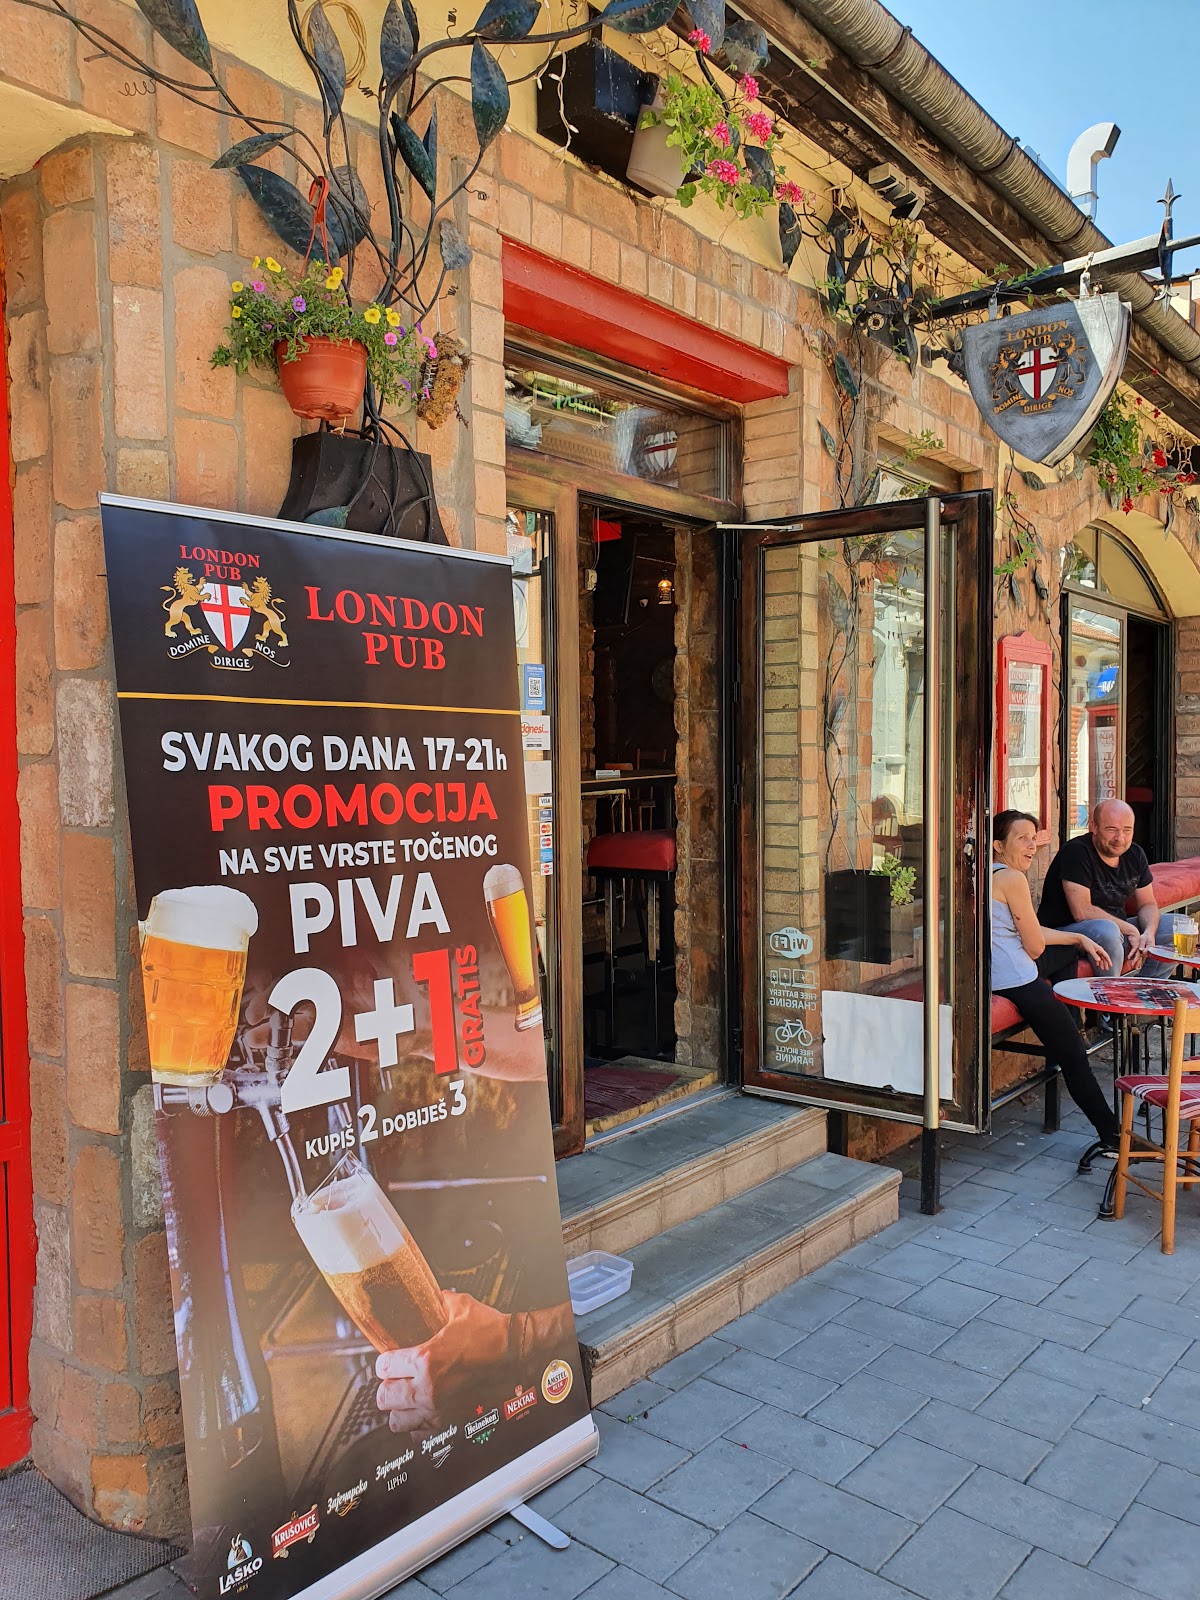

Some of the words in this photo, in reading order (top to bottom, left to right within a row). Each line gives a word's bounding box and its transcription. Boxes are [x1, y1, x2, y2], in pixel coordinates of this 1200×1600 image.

[1008, 321, 1068, 342] LONDON
[1024, 337, 1052, 348] PUB
[1058, 385, 1074, 396] NOS
[993, 393, 1024, 414] DOMINE
[1023, 401, 1053, 413] DIRIGE
[180, 545, 260, 567] LONDON
[204, 563, 242, 581] PUB
[304, 586, 485, 637] LONDON
[169, 634, 211, 657] DOMINE
[254, 641, 276, 659] NOS
[362, 632, 446, 670] PUB
[213, 656, 251, 669] DIRIGE
[161, 731, 314, 773] SVAKOG
[324, 736, 416, 771] DANA
[423, 737, 507, 771] 17-21h
[207, 782, 498, 832] PROMOCIJA
[219, 849, 259, 876] NA
[264, 845, 313, 873] SVE
[318, 841, 396, 870] VRSTE
[400, 831, 498, 862] TOČENOG
[289, 872, 451, 954] PIVA
[454, 943, 485, 1068] GRATIS
[305, 1124, 356, 1160] KUPIŠ
[357, 1104, 379, 1144] 2
[382, 1099, 449, 1137] DOBIJEŠ
[448, 1079, 468, 1117] 3
[547, 1371, 567, 1387] AMSTEL
[507, 1392, 535, 1415] NEKTAR
[467, 1413, 497, 1435] Heineken
[387, 1472, 408, 1492] ЦРНО
[274, 1513, 317, 1547] KRUŠOVICE
[219, 1557, 263, 1595] LAŠKO
